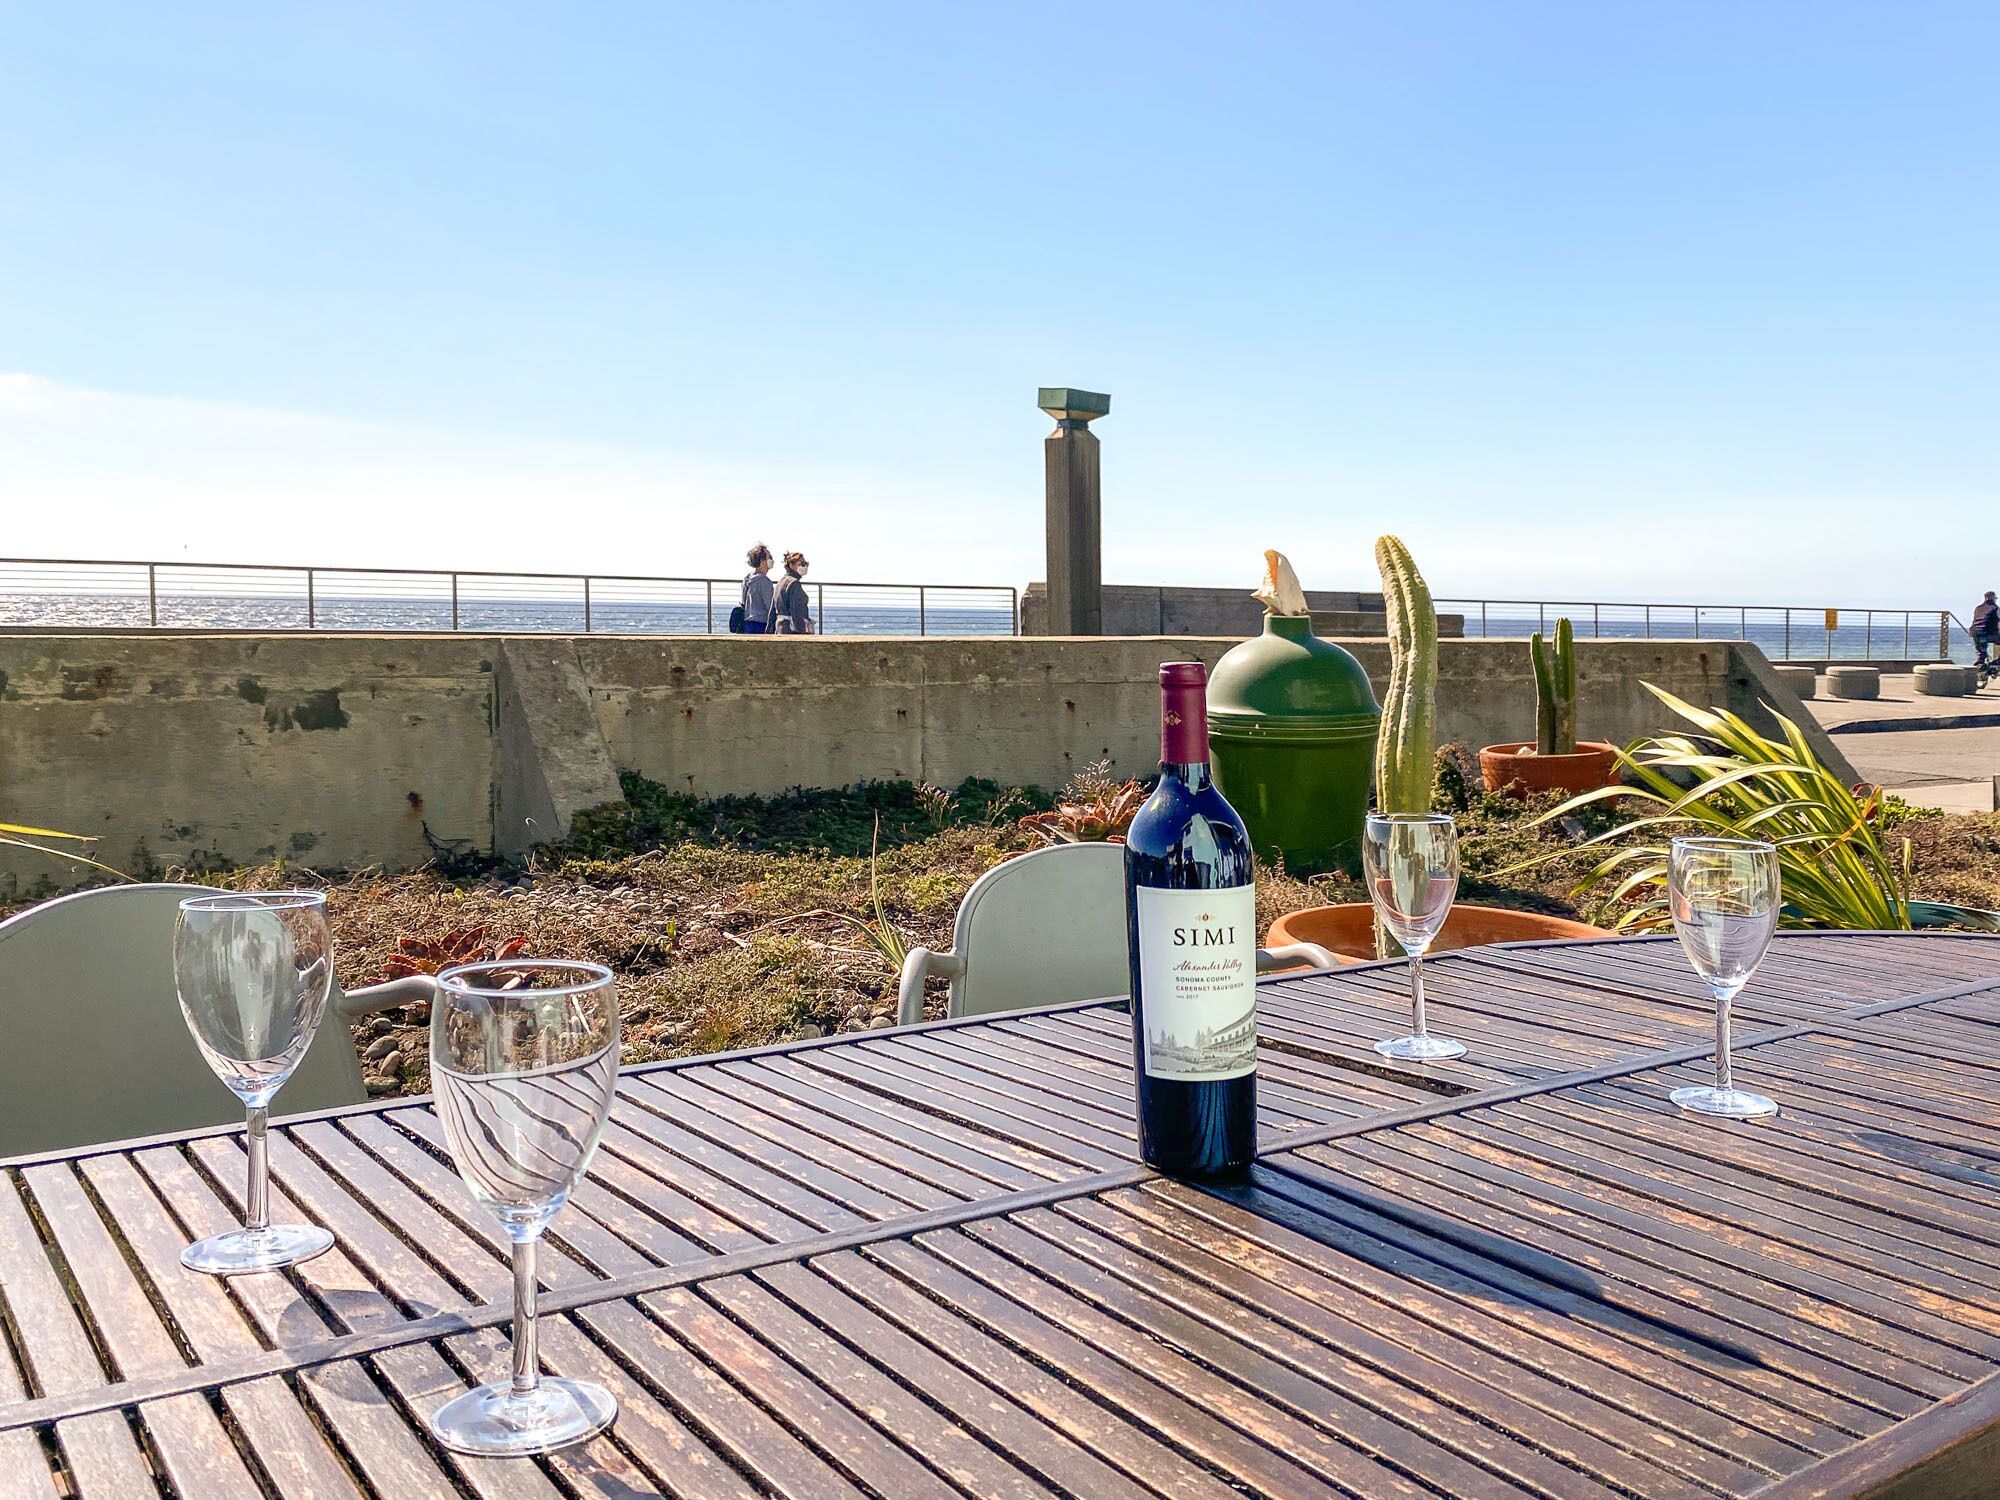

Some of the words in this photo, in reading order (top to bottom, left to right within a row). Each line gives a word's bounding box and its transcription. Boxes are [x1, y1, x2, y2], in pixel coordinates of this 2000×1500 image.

[1173, 926, 1235, 947] SIMI
[1173, 960, 1220, 971] Alexander
[1212, 982, 1243, 991] SAUVIGNON
